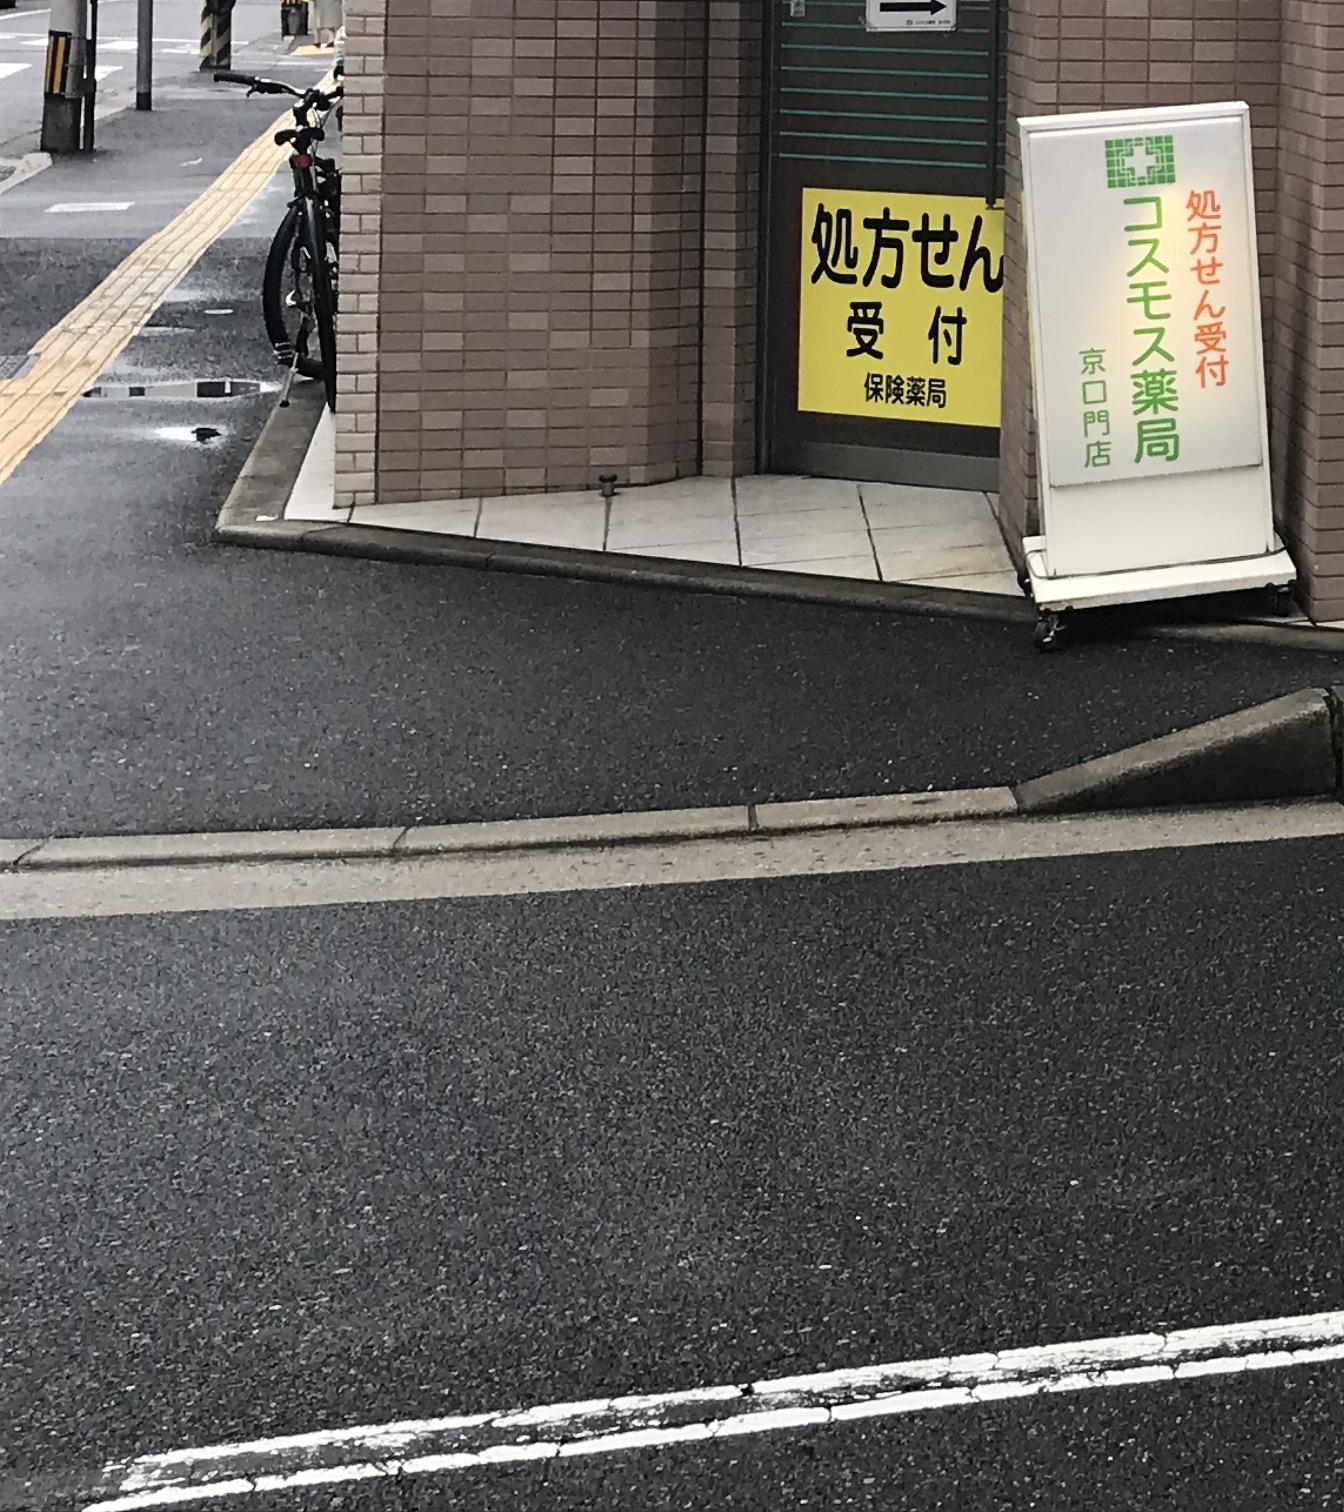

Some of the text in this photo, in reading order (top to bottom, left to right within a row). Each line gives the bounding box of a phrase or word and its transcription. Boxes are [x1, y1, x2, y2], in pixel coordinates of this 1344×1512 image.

[810, 202, 1004, 294] 処方せん
[1185, 189, 1230, 389] 処方せん受付
[863, 372, 947, 409] 保険薬局
[1122, 195, 1181, 465] コスモス薬局
[1079, 347, 1112, 469] 京口門店
